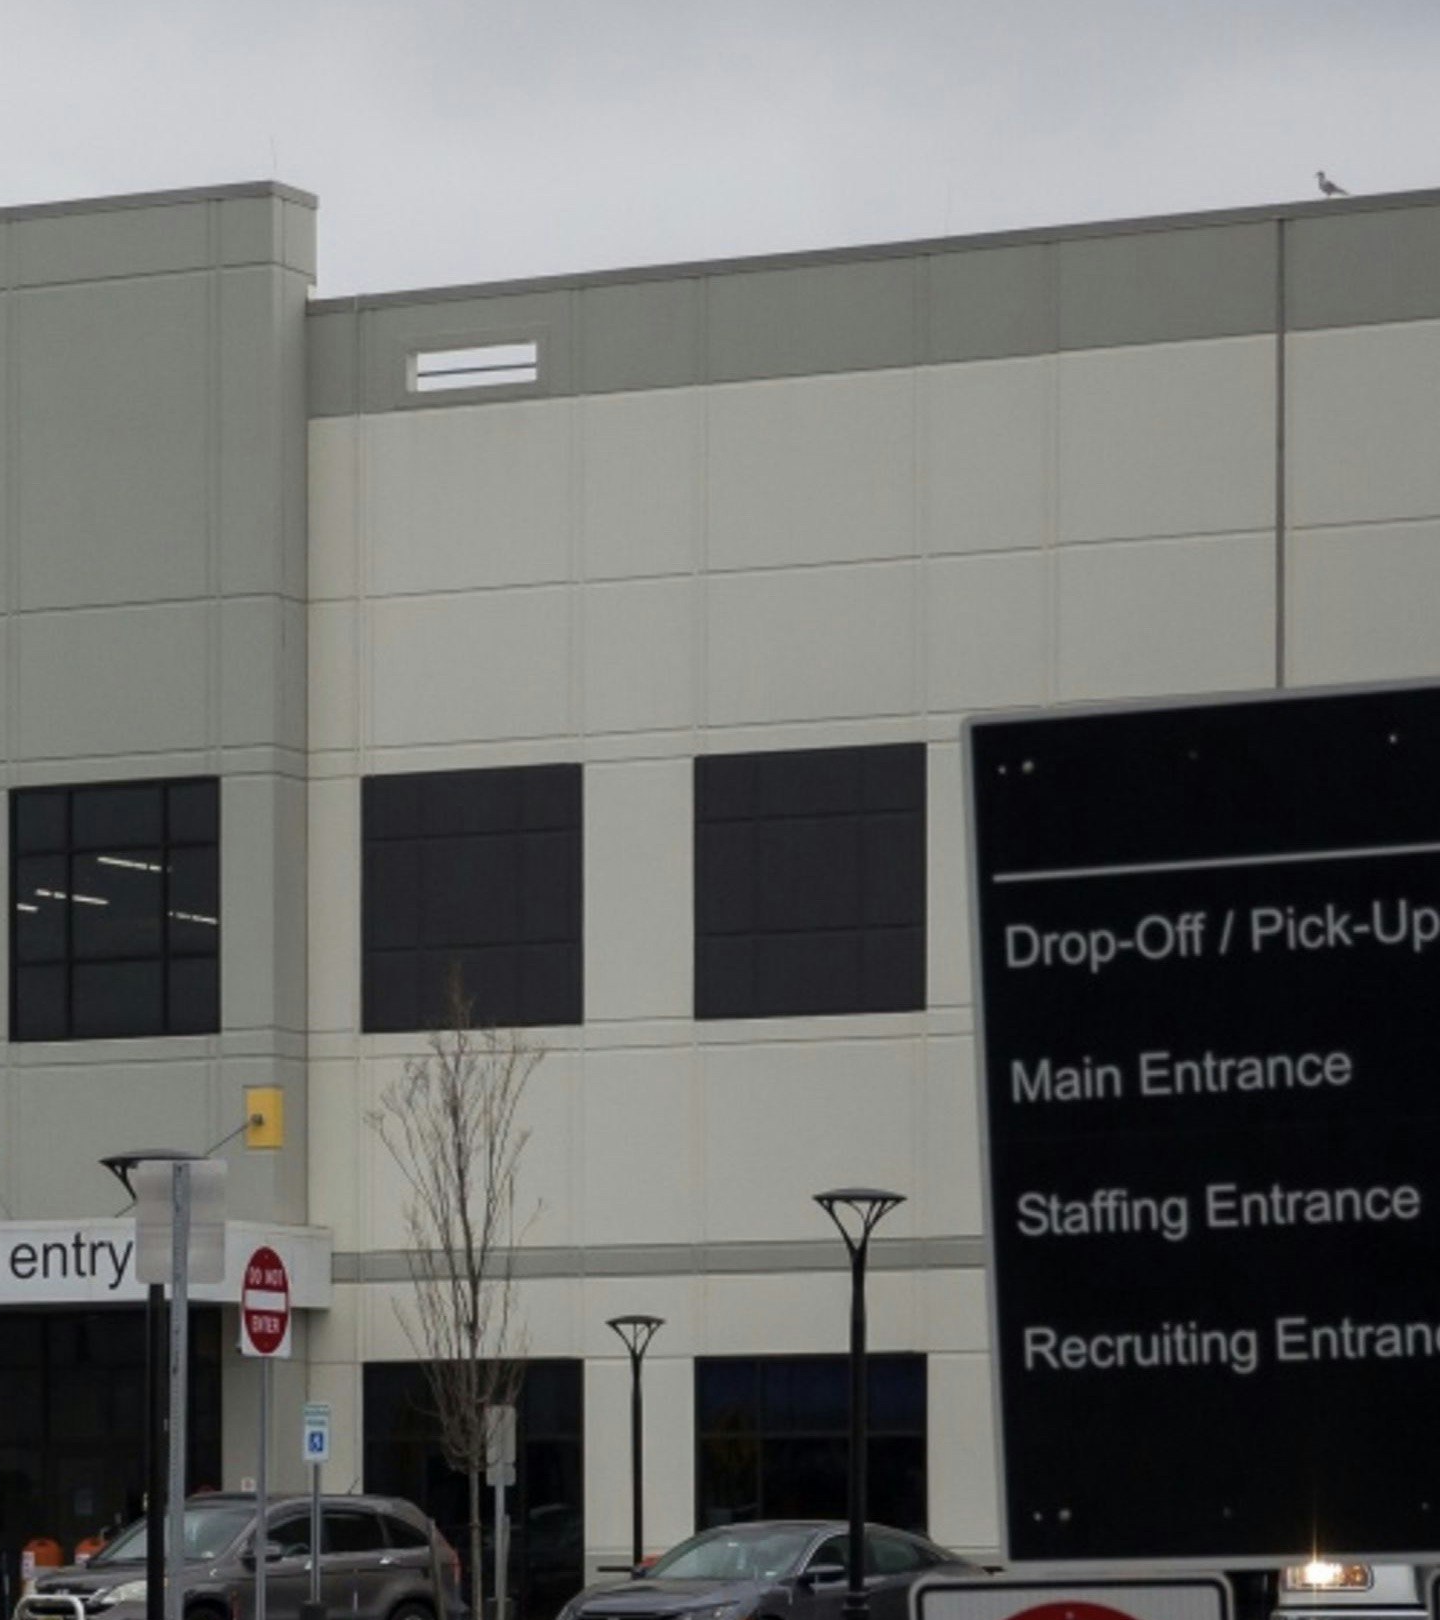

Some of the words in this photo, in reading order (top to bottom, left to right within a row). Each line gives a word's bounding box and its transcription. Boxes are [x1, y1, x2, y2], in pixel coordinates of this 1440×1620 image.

[1005, 911, 1206, 973] Drop-Off
[1251, 899, 1440, 953] Pick-Up
[1011, 1056, 1121, 1103] Main
[1139, 1051, 1353, 1096] Entrance
[1017, 1188, 1188, 1241] Staffing
[1205, 1183, 1420, 1228] Entrance
[9, 1231, 134, 1290] entry
[249, 1266, 263, 1285] DO
[265, 1268, 283, 1286] NOT
[251, 1315, 280, 1334] ENTER
[1024, 1321, 1258, 1374] Recruiting
